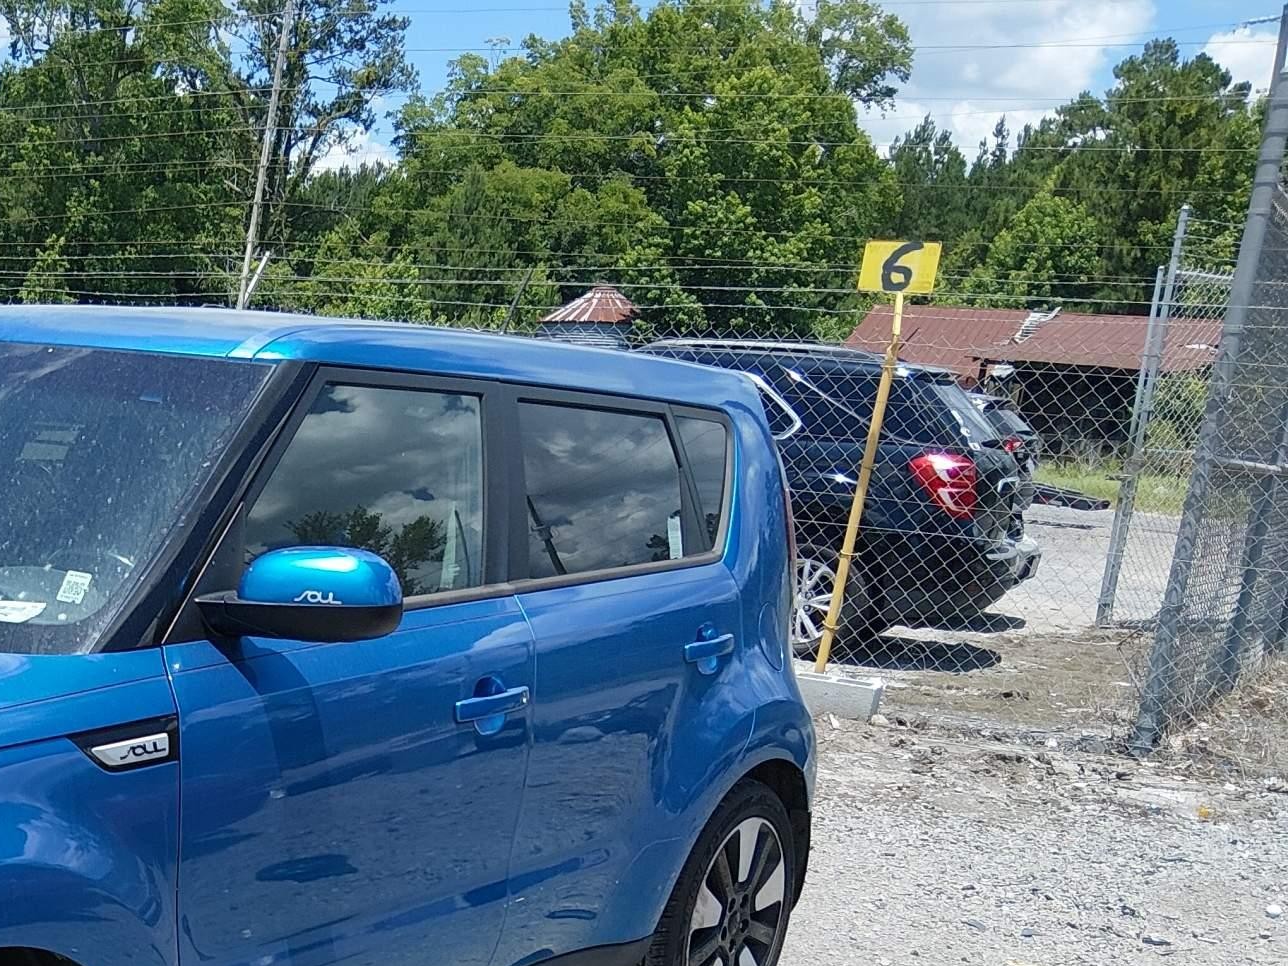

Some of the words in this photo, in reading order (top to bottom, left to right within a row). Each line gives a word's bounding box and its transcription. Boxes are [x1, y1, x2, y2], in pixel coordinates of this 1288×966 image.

[881, 240, 924, 292] 6
[293, 590, 343, 605] SOUL
[119, 741, 167, 761] SOUL
